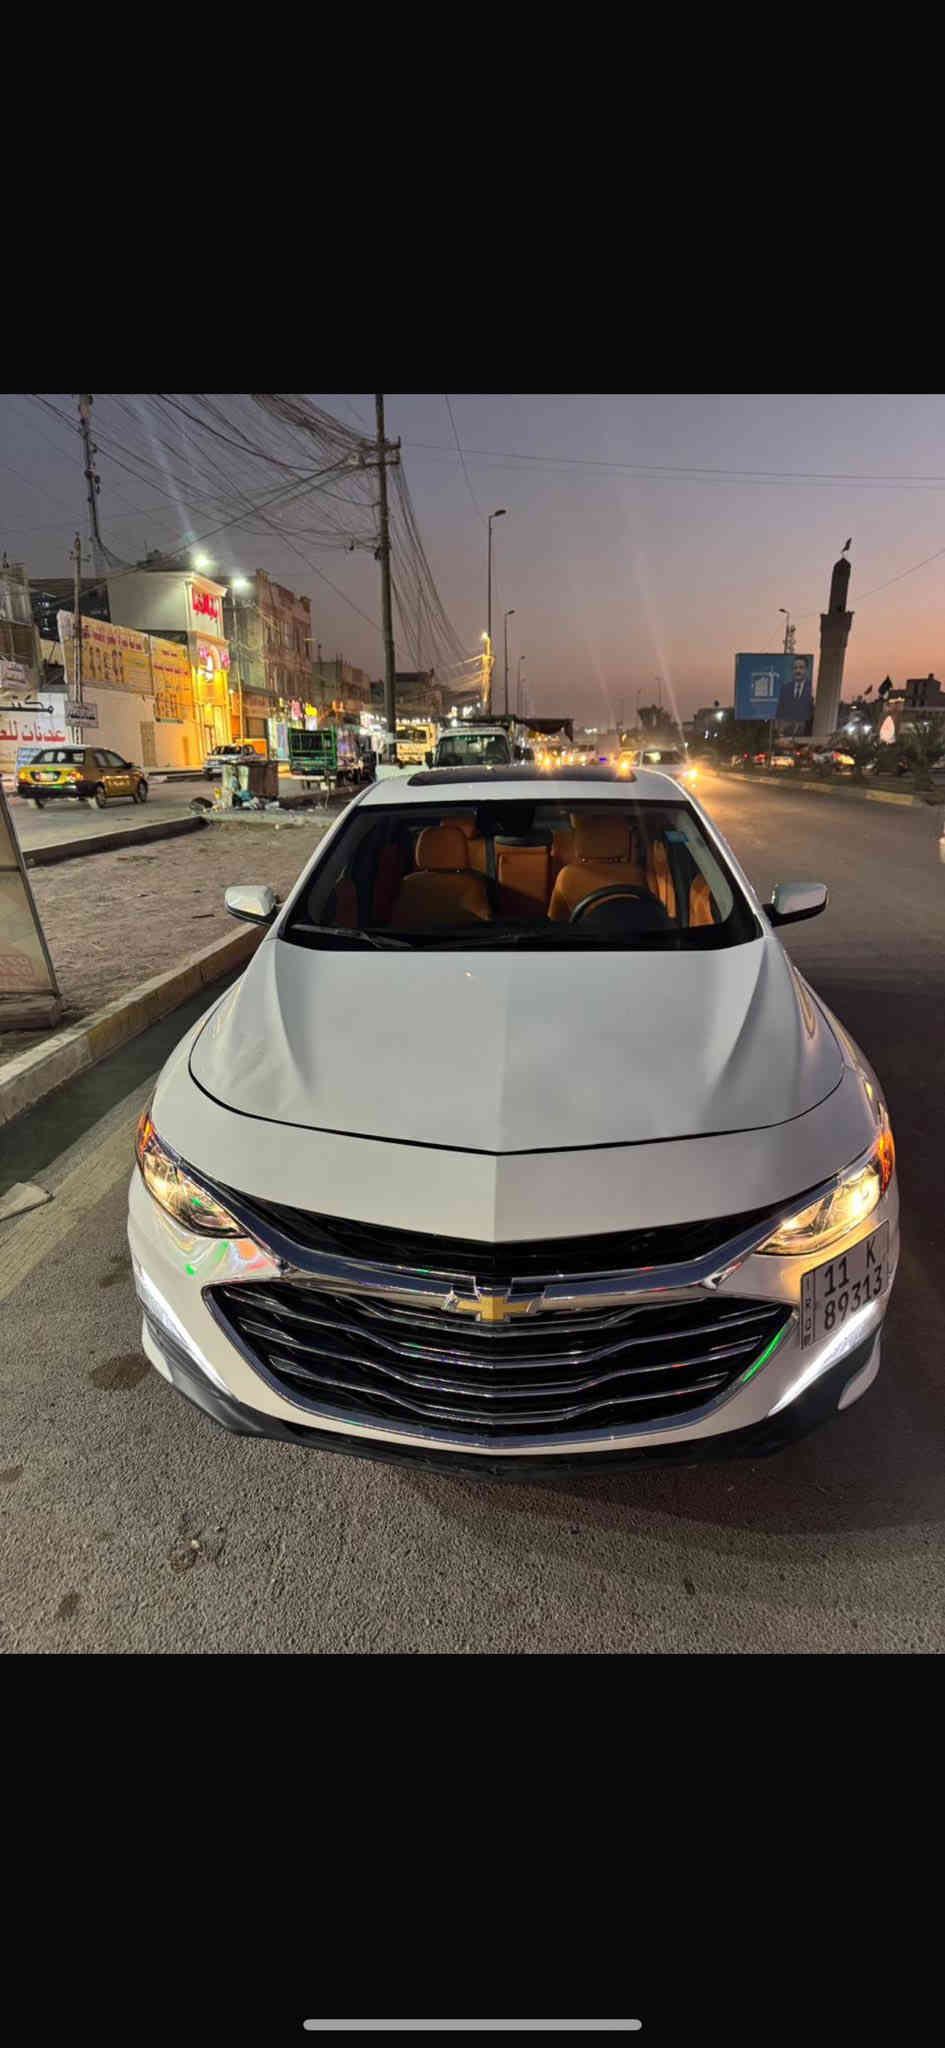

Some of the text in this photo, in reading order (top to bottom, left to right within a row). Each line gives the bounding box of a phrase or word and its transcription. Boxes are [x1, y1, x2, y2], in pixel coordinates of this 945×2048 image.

[823, 1264, 882, 1331] 89313
[824, 1236, 876, 1298] 11 K
